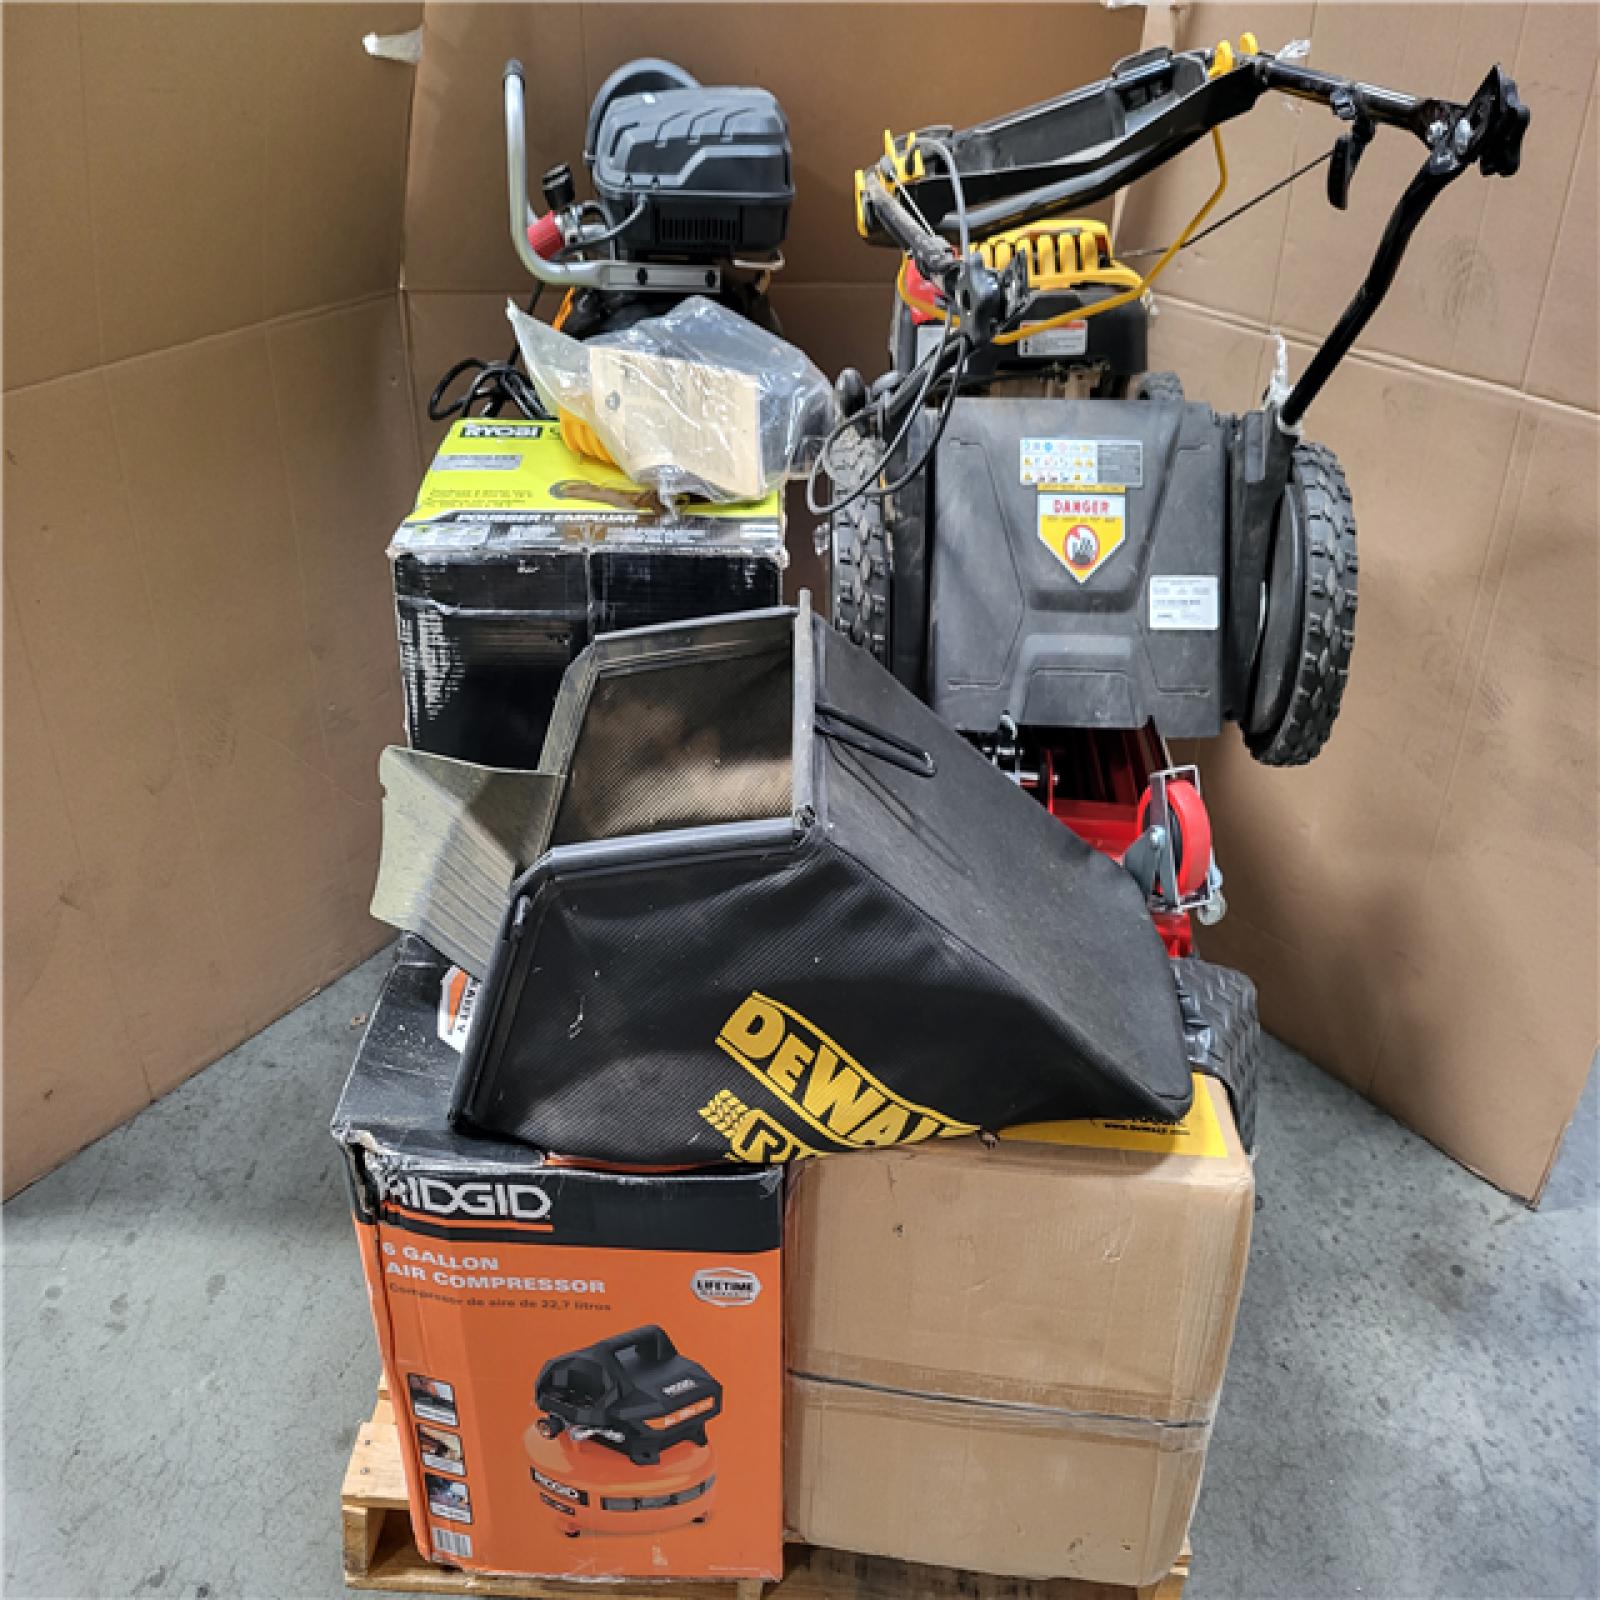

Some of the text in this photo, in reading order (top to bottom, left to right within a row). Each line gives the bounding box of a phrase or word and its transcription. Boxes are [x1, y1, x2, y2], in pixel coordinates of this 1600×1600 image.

[463, 424, 540, 438] RYOBI
[1054, 499, 1110, 513] DANGER
[719, 995, 981, 1148] DEWA
[375, 1176, 552, 1219] RIDGID
[403, 1246, 499, 1270] GALLON
[387, 1262, 606, 1294] AIR COMPRESSOR
[697, 1279, 753, 1291] LIFETIME
